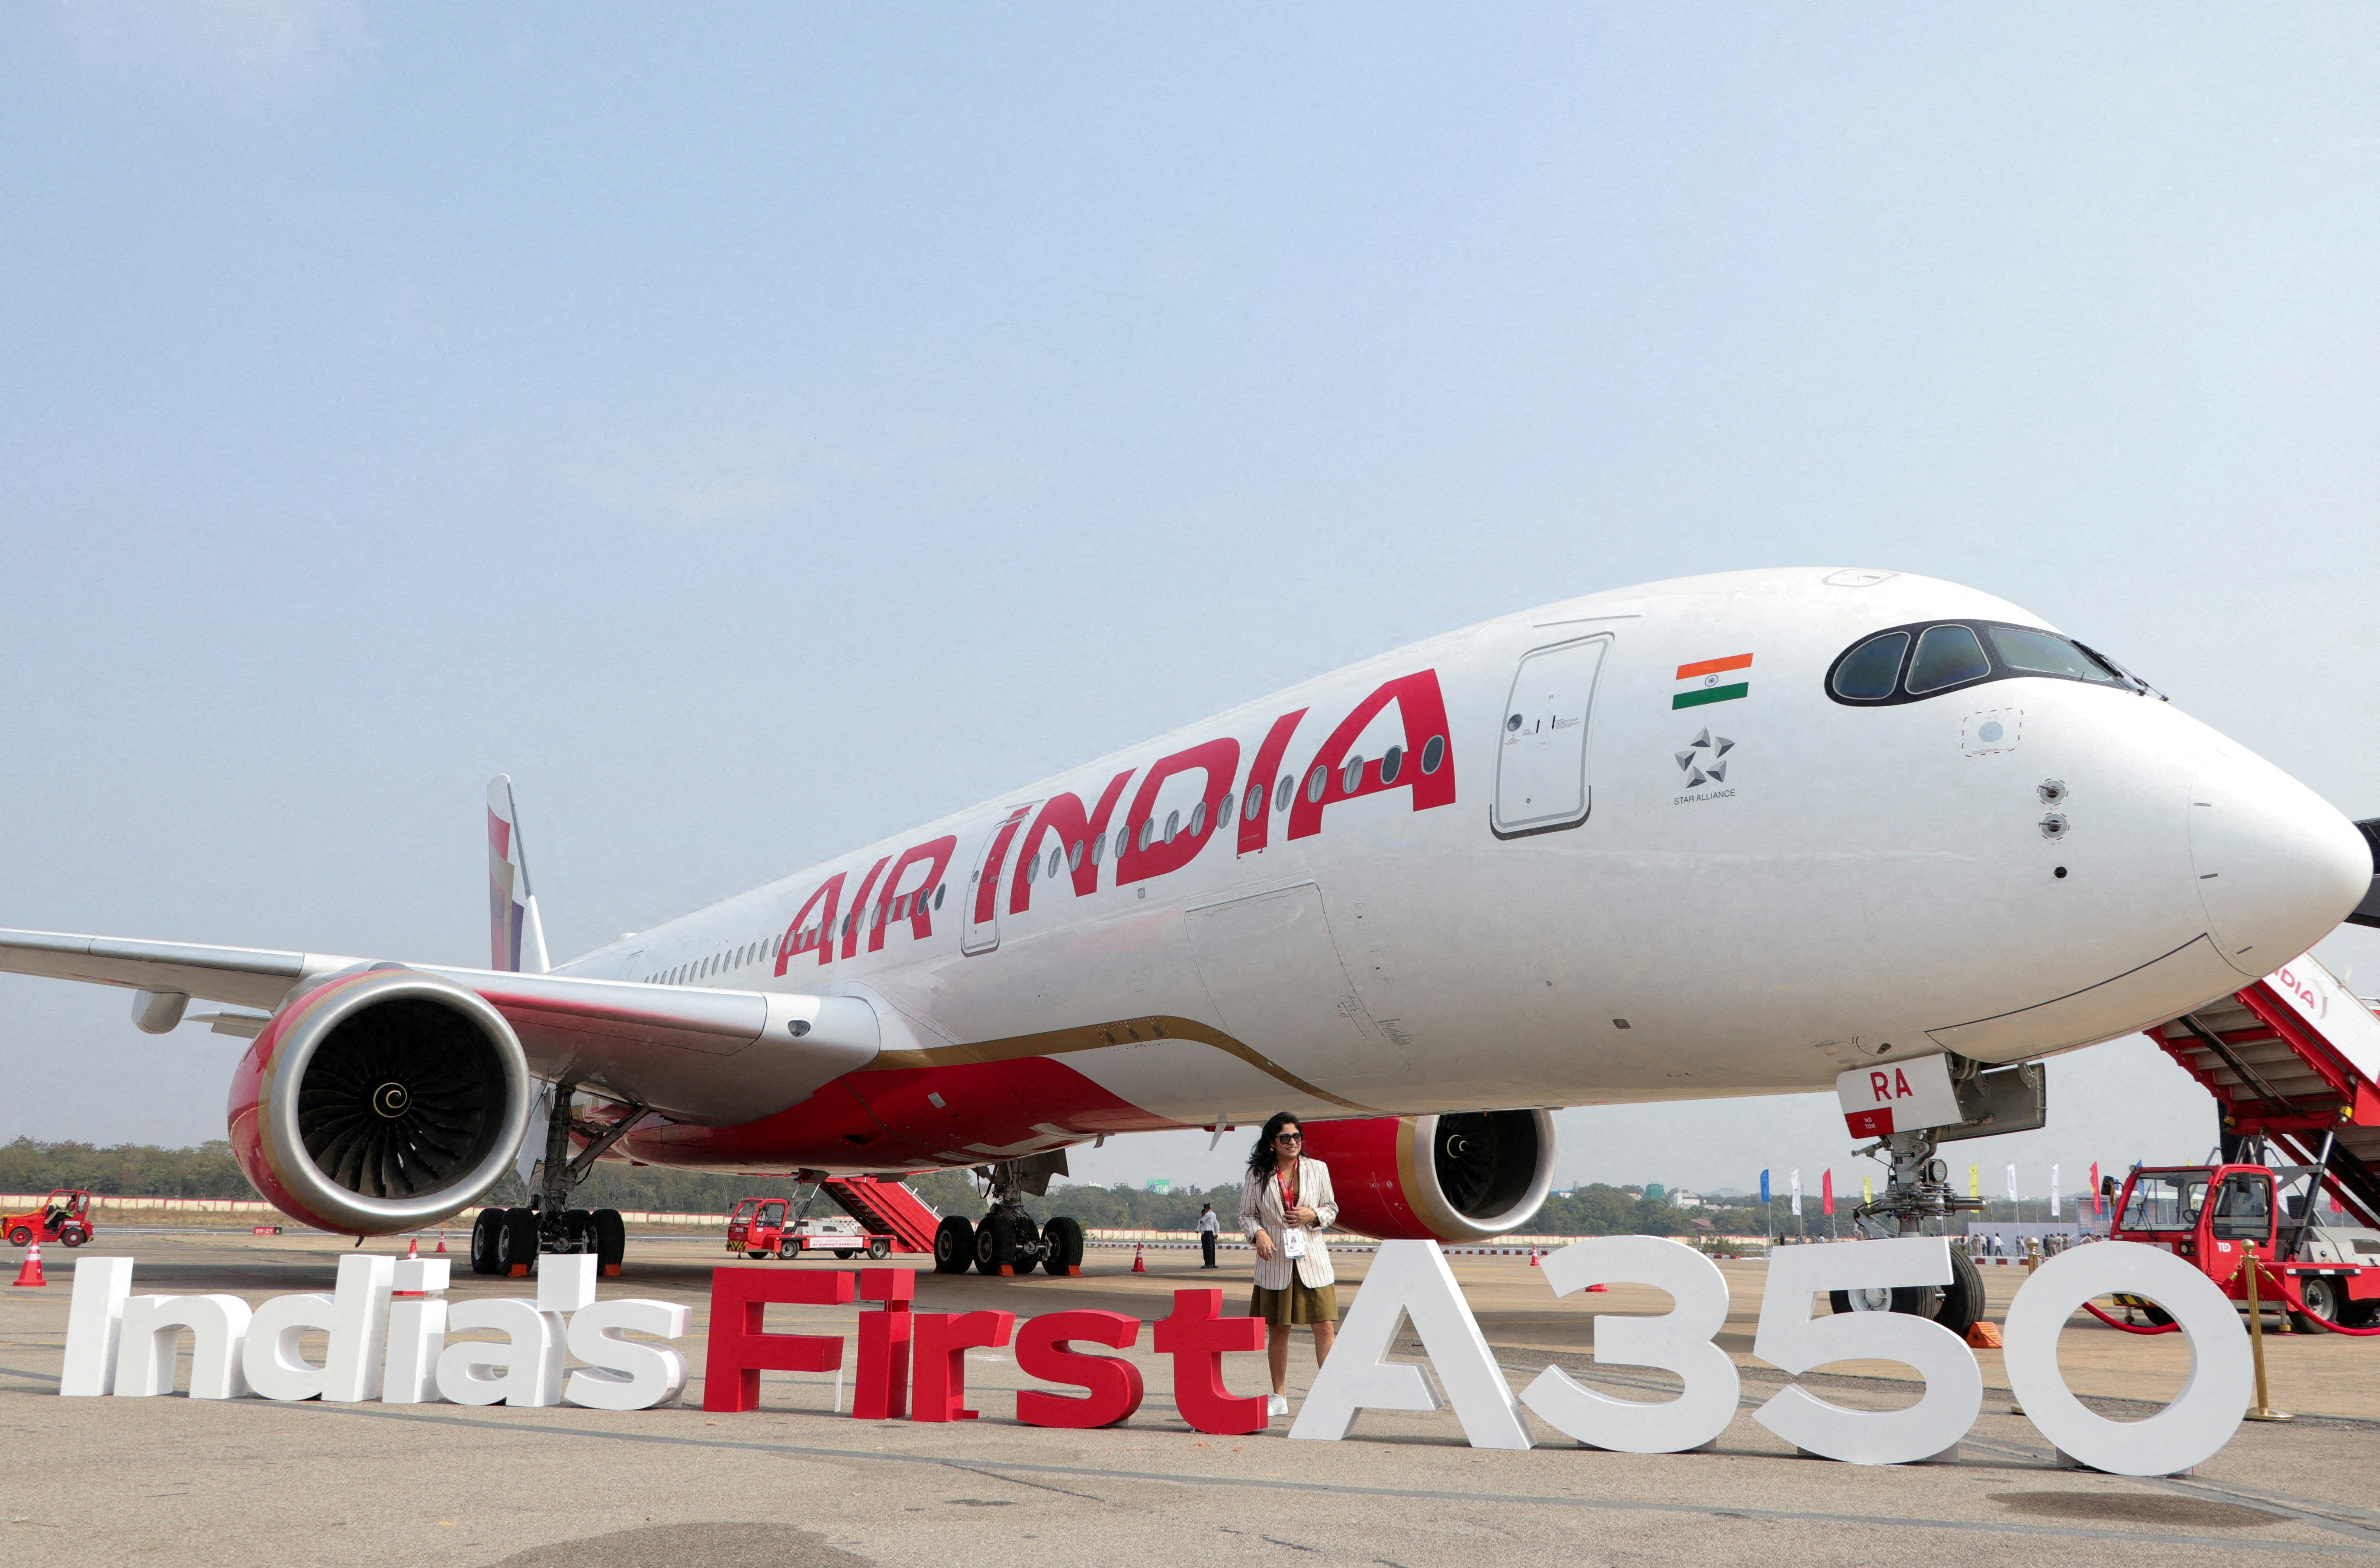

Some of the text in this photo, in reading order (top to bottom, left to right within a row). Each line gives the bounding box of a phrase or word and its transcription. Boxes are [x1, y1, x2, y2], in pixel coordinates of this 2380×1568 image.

[1674, 789, 1735, 805] STAR ALLIANCE
[774, 668, 1455, 977] AIR INDIA
[2274, 968, 2314, 1009] DIA
[1870, 1068, 1914, 1101] RA
[61, 1235, 2253, 1476] India's First A350
